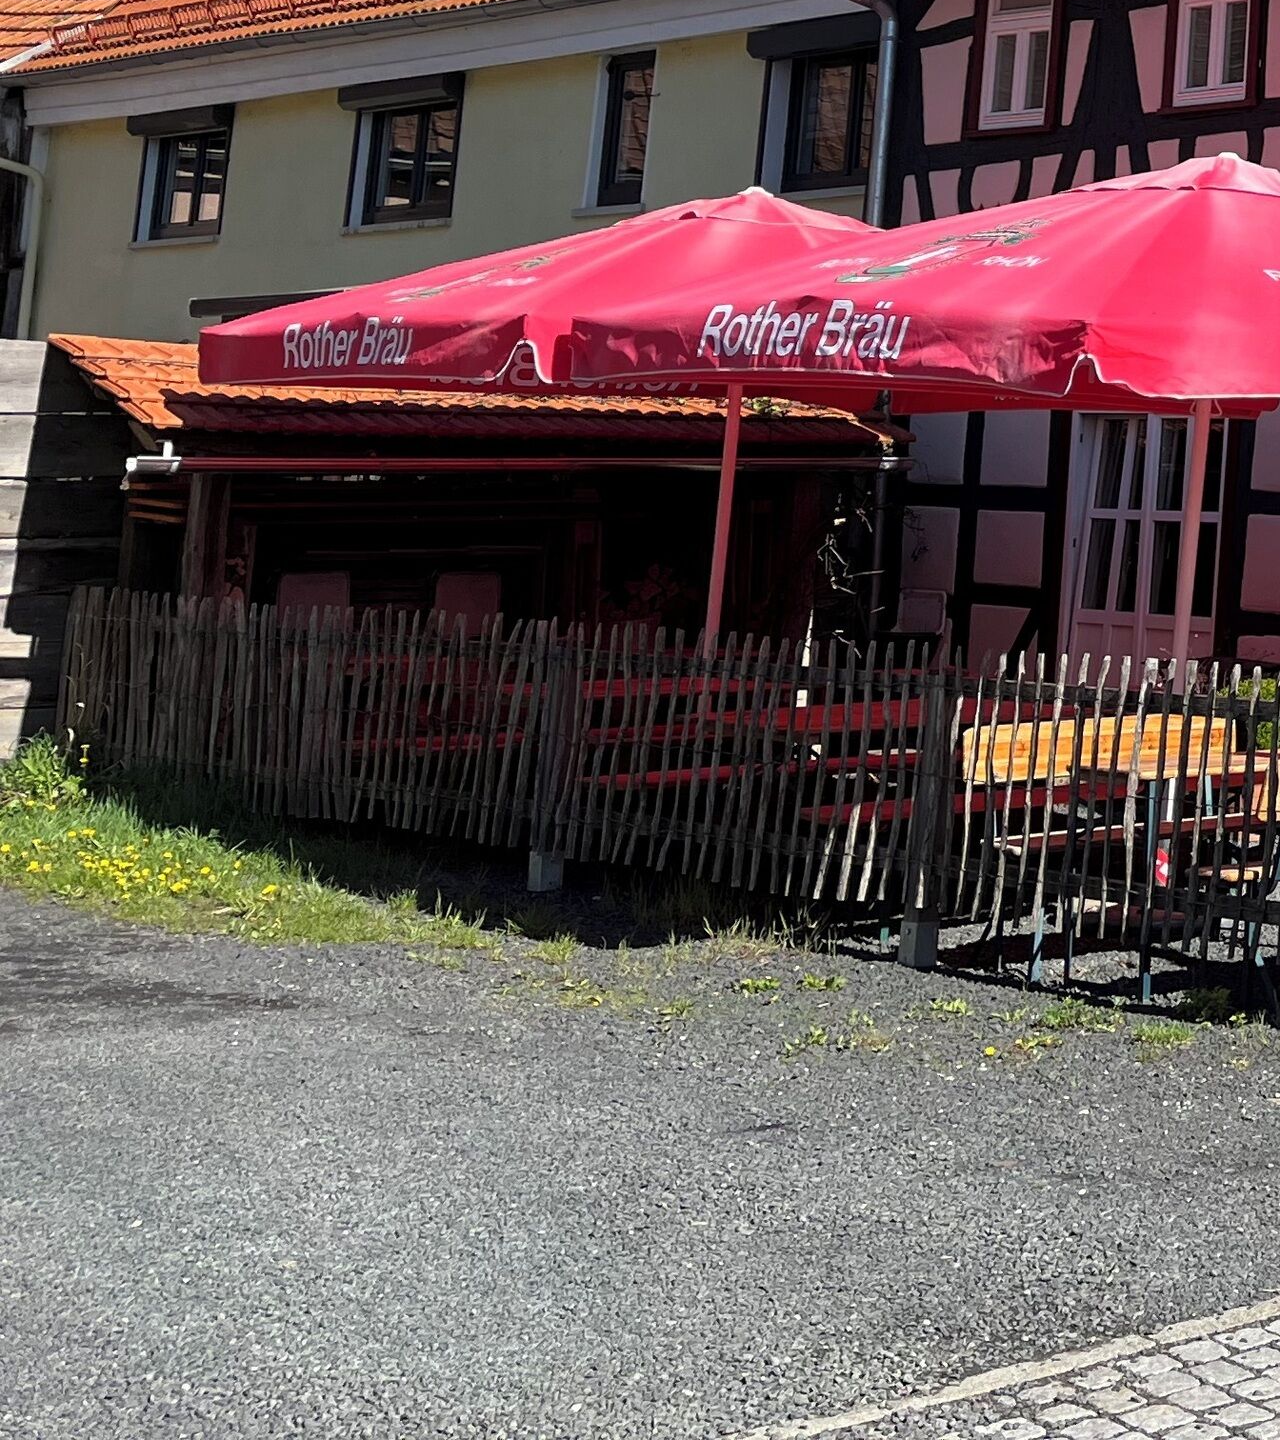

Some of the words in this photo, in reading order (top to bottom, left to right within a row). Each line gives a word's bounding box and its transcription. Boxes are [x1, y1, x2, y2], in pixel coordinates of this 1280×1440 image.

[283, 321, 358, 369] Rother
[357, 316, 413, 365] Bräu
[696, 301, 819, 358] Rother
[815, 299, 911, 360] Bräu
